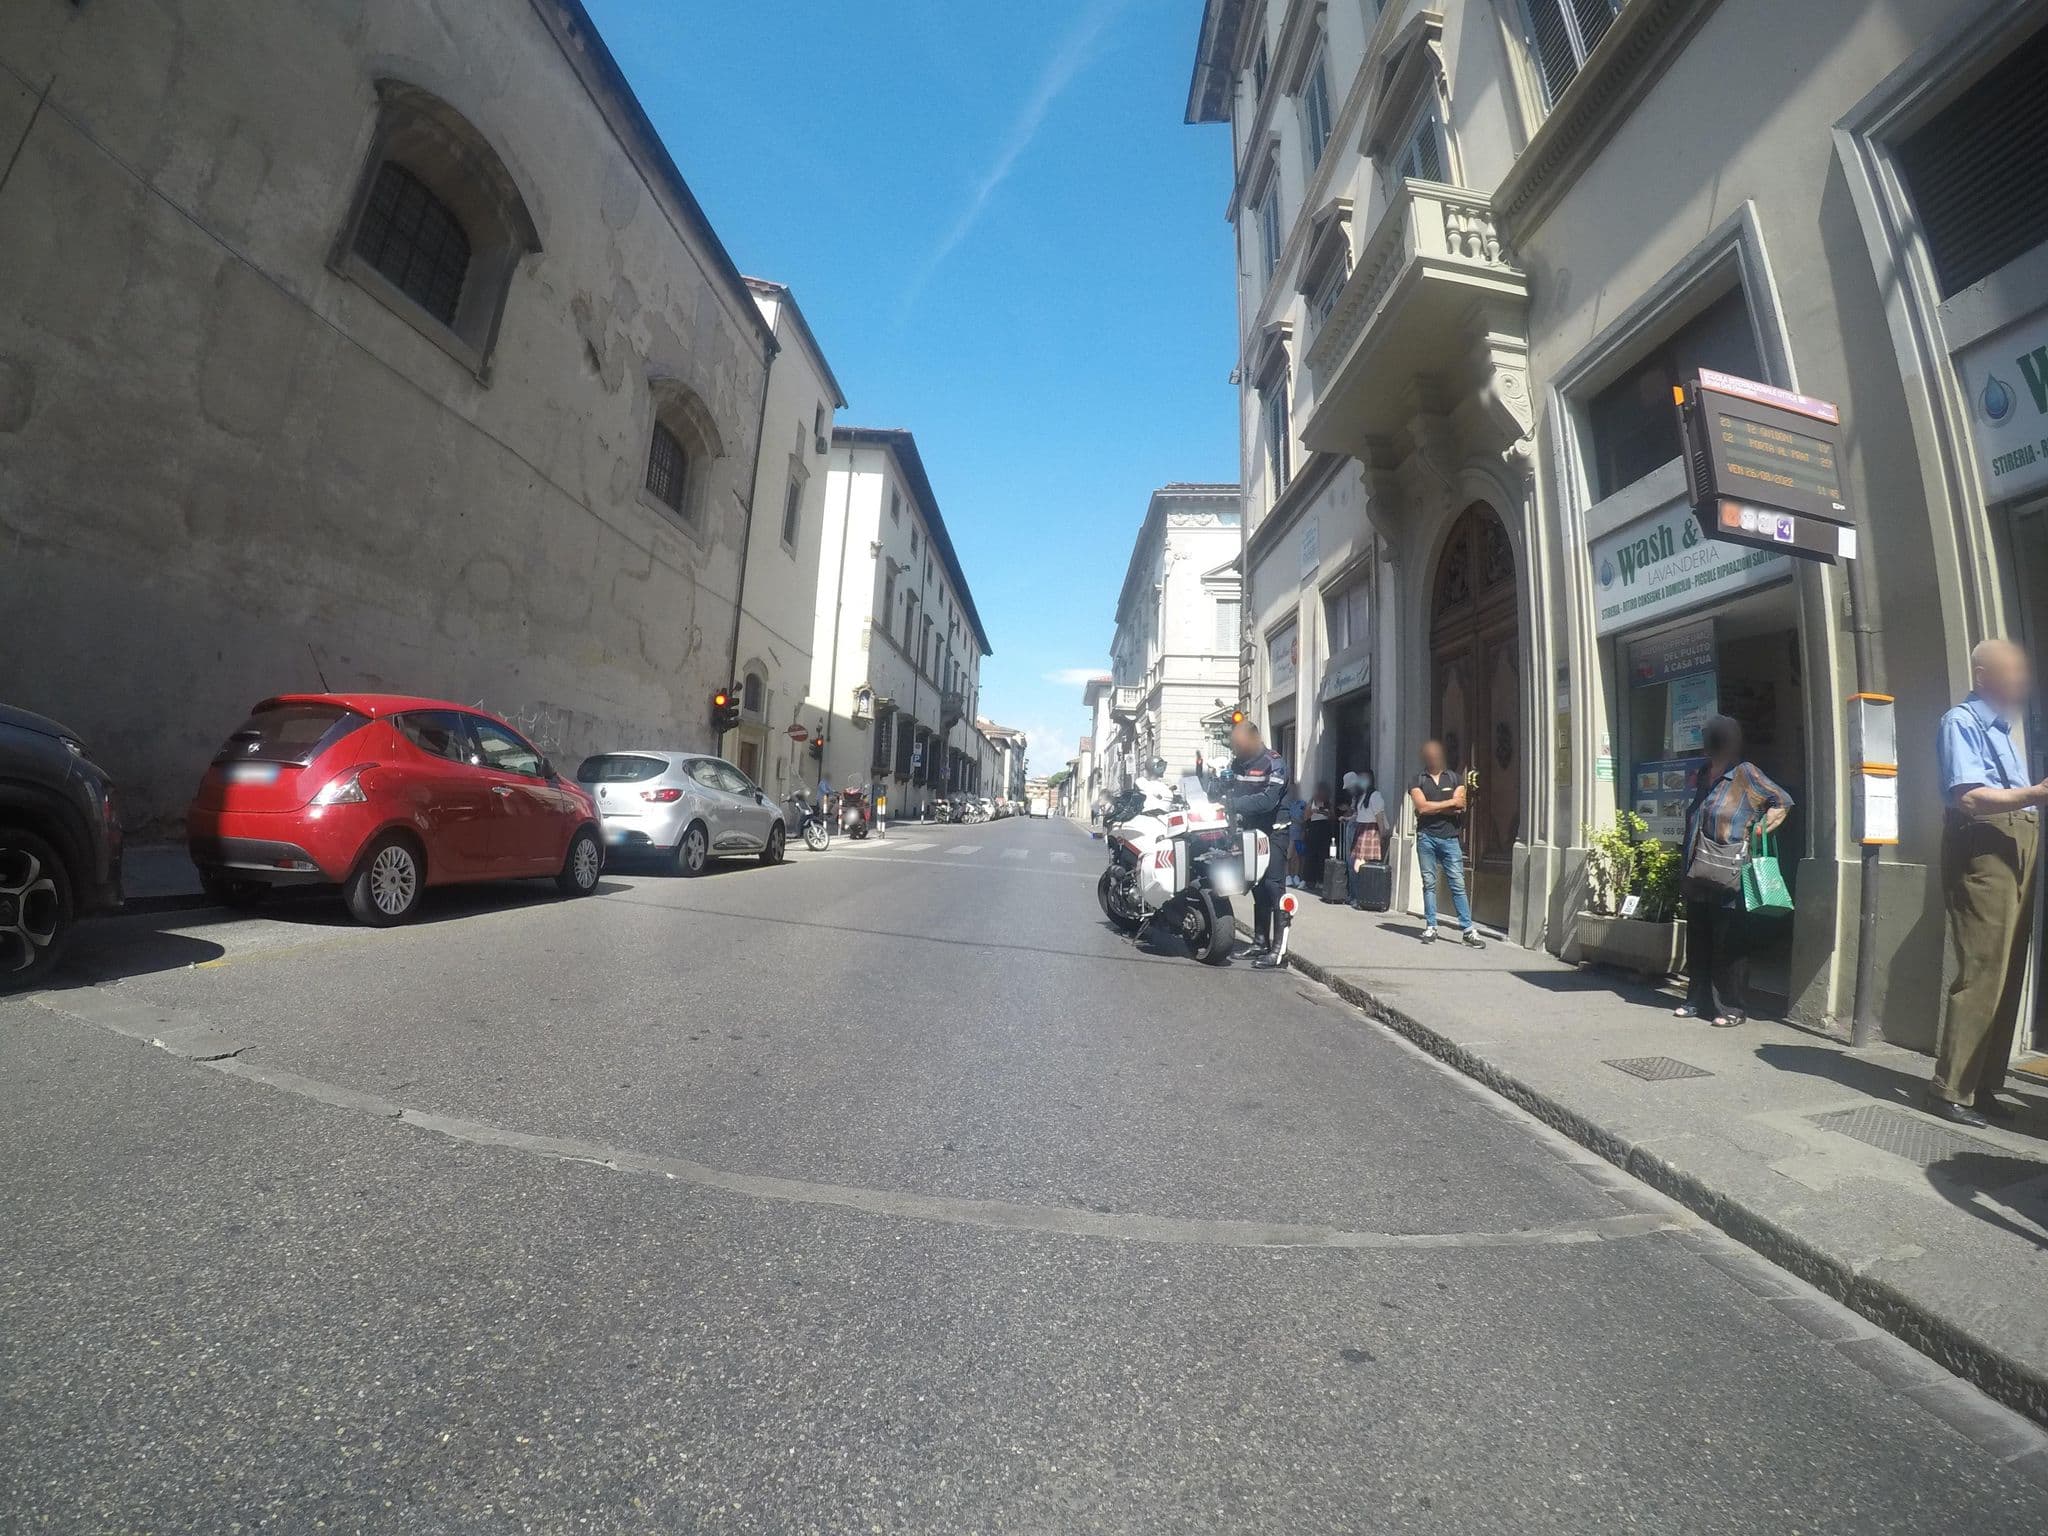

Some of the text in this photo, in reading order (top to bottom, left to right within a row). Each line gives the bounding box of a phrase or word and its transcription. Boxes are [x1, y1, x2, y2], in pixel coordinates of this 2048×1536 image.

[1992, 444, 2036, 477] STIRERIA
[1617, 524, 1675, 587] Wash
[1682, 518, 1699, 549] &
[1648, 545, 1720, 586] LAVANDERIA
[1664, 641, 1711, 663] DEL PULITO
[1671, 658, 1693, 672] CASA
[1695, 653, 1712, 666] TUA
